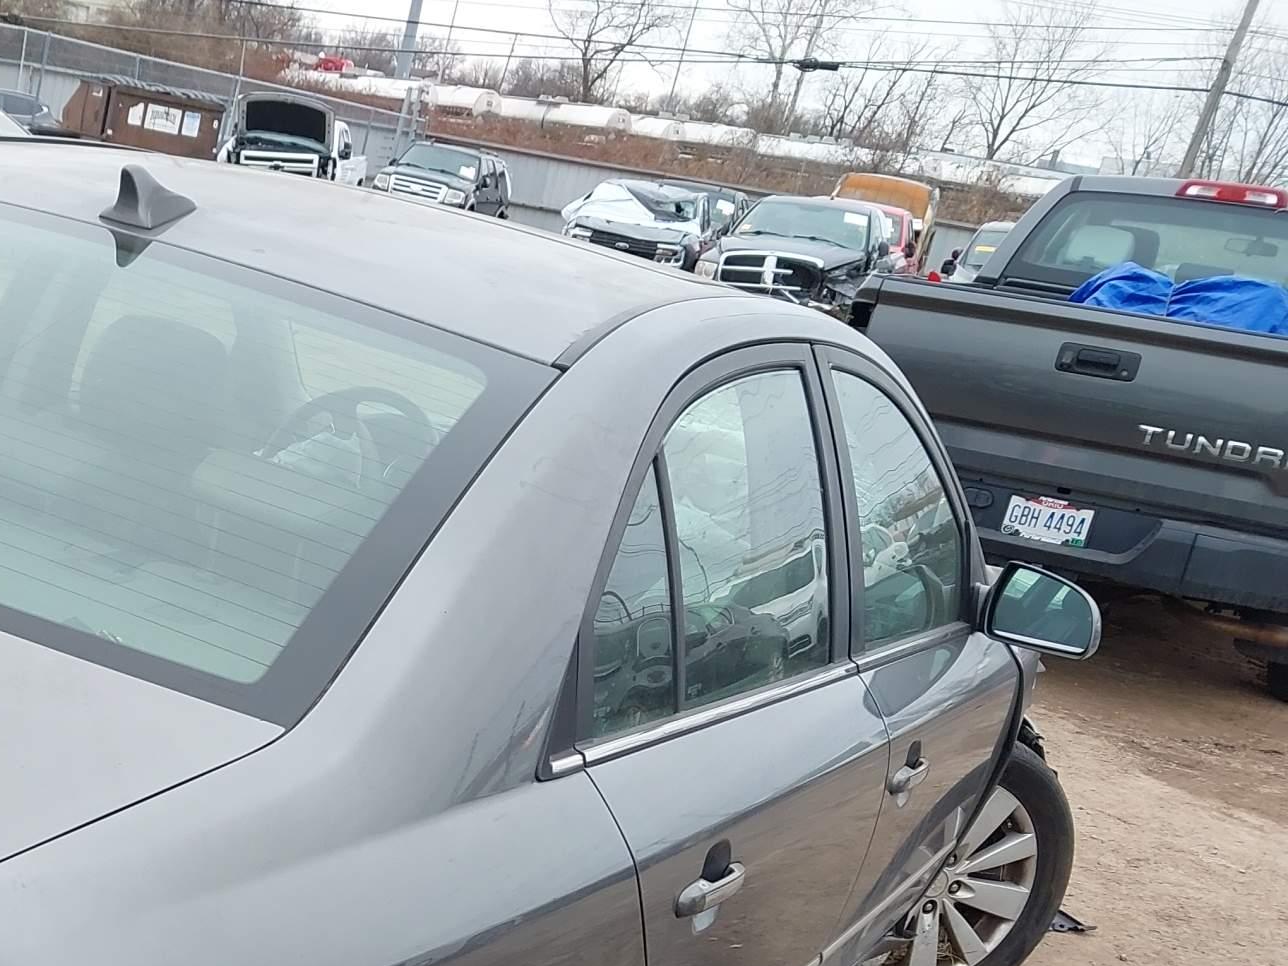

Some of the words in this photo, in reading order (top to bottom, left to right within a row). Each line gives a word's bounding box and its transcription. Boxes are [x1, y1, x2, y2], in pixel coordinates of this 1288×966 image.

[1137, 424, 1288, 470] TUNDR
[1008, 503, 1043, 529] GBH
[1043, 511, 1087, 538] 4494
